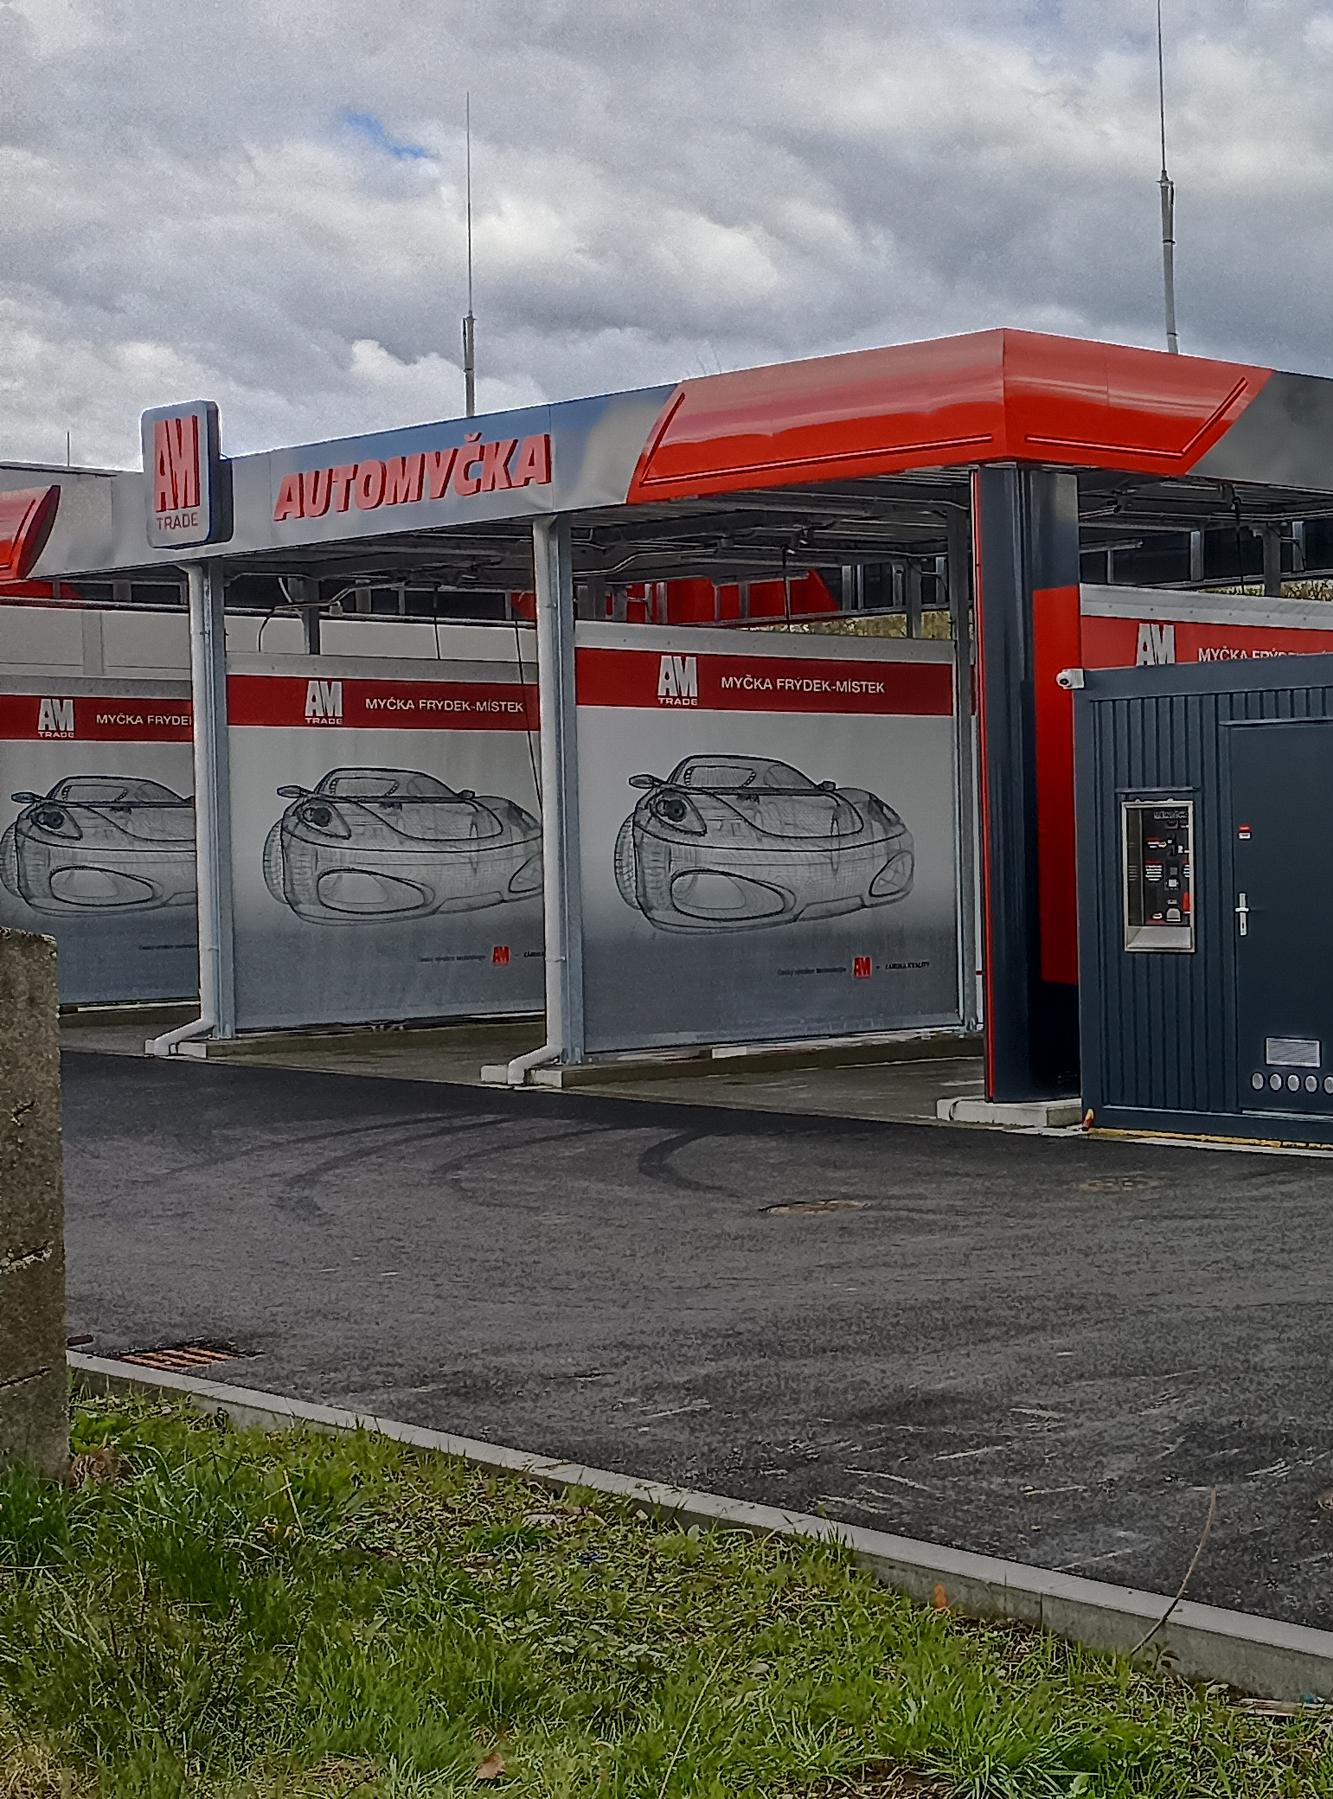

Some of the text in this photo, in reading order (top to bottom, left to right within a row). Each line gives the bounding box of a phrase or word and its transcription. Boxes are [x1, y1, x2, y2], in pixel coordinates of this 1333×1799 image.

[154, 415, 200, 512] AM
[273, 432, 552, 521] AUTOMYČKA
[156, 512, 199, 530] TRADE
[1136, 623, 1176, 665] AM
[657, 655, 698, 697] AM
[721, 674, 885, 693] MYČKA FRÝDEK-MÍSTEK
[304, 680, 343, 717] AM
[365, 697, 524, 713] MYČKA FRÝDEK-MÍSTEK
[658, 697, 698, 706] TRADE
[38, 699, 75, 731] AM
[96, 712, 144, 725] MYČKA
[305, 717, 343, 725] TRADE
